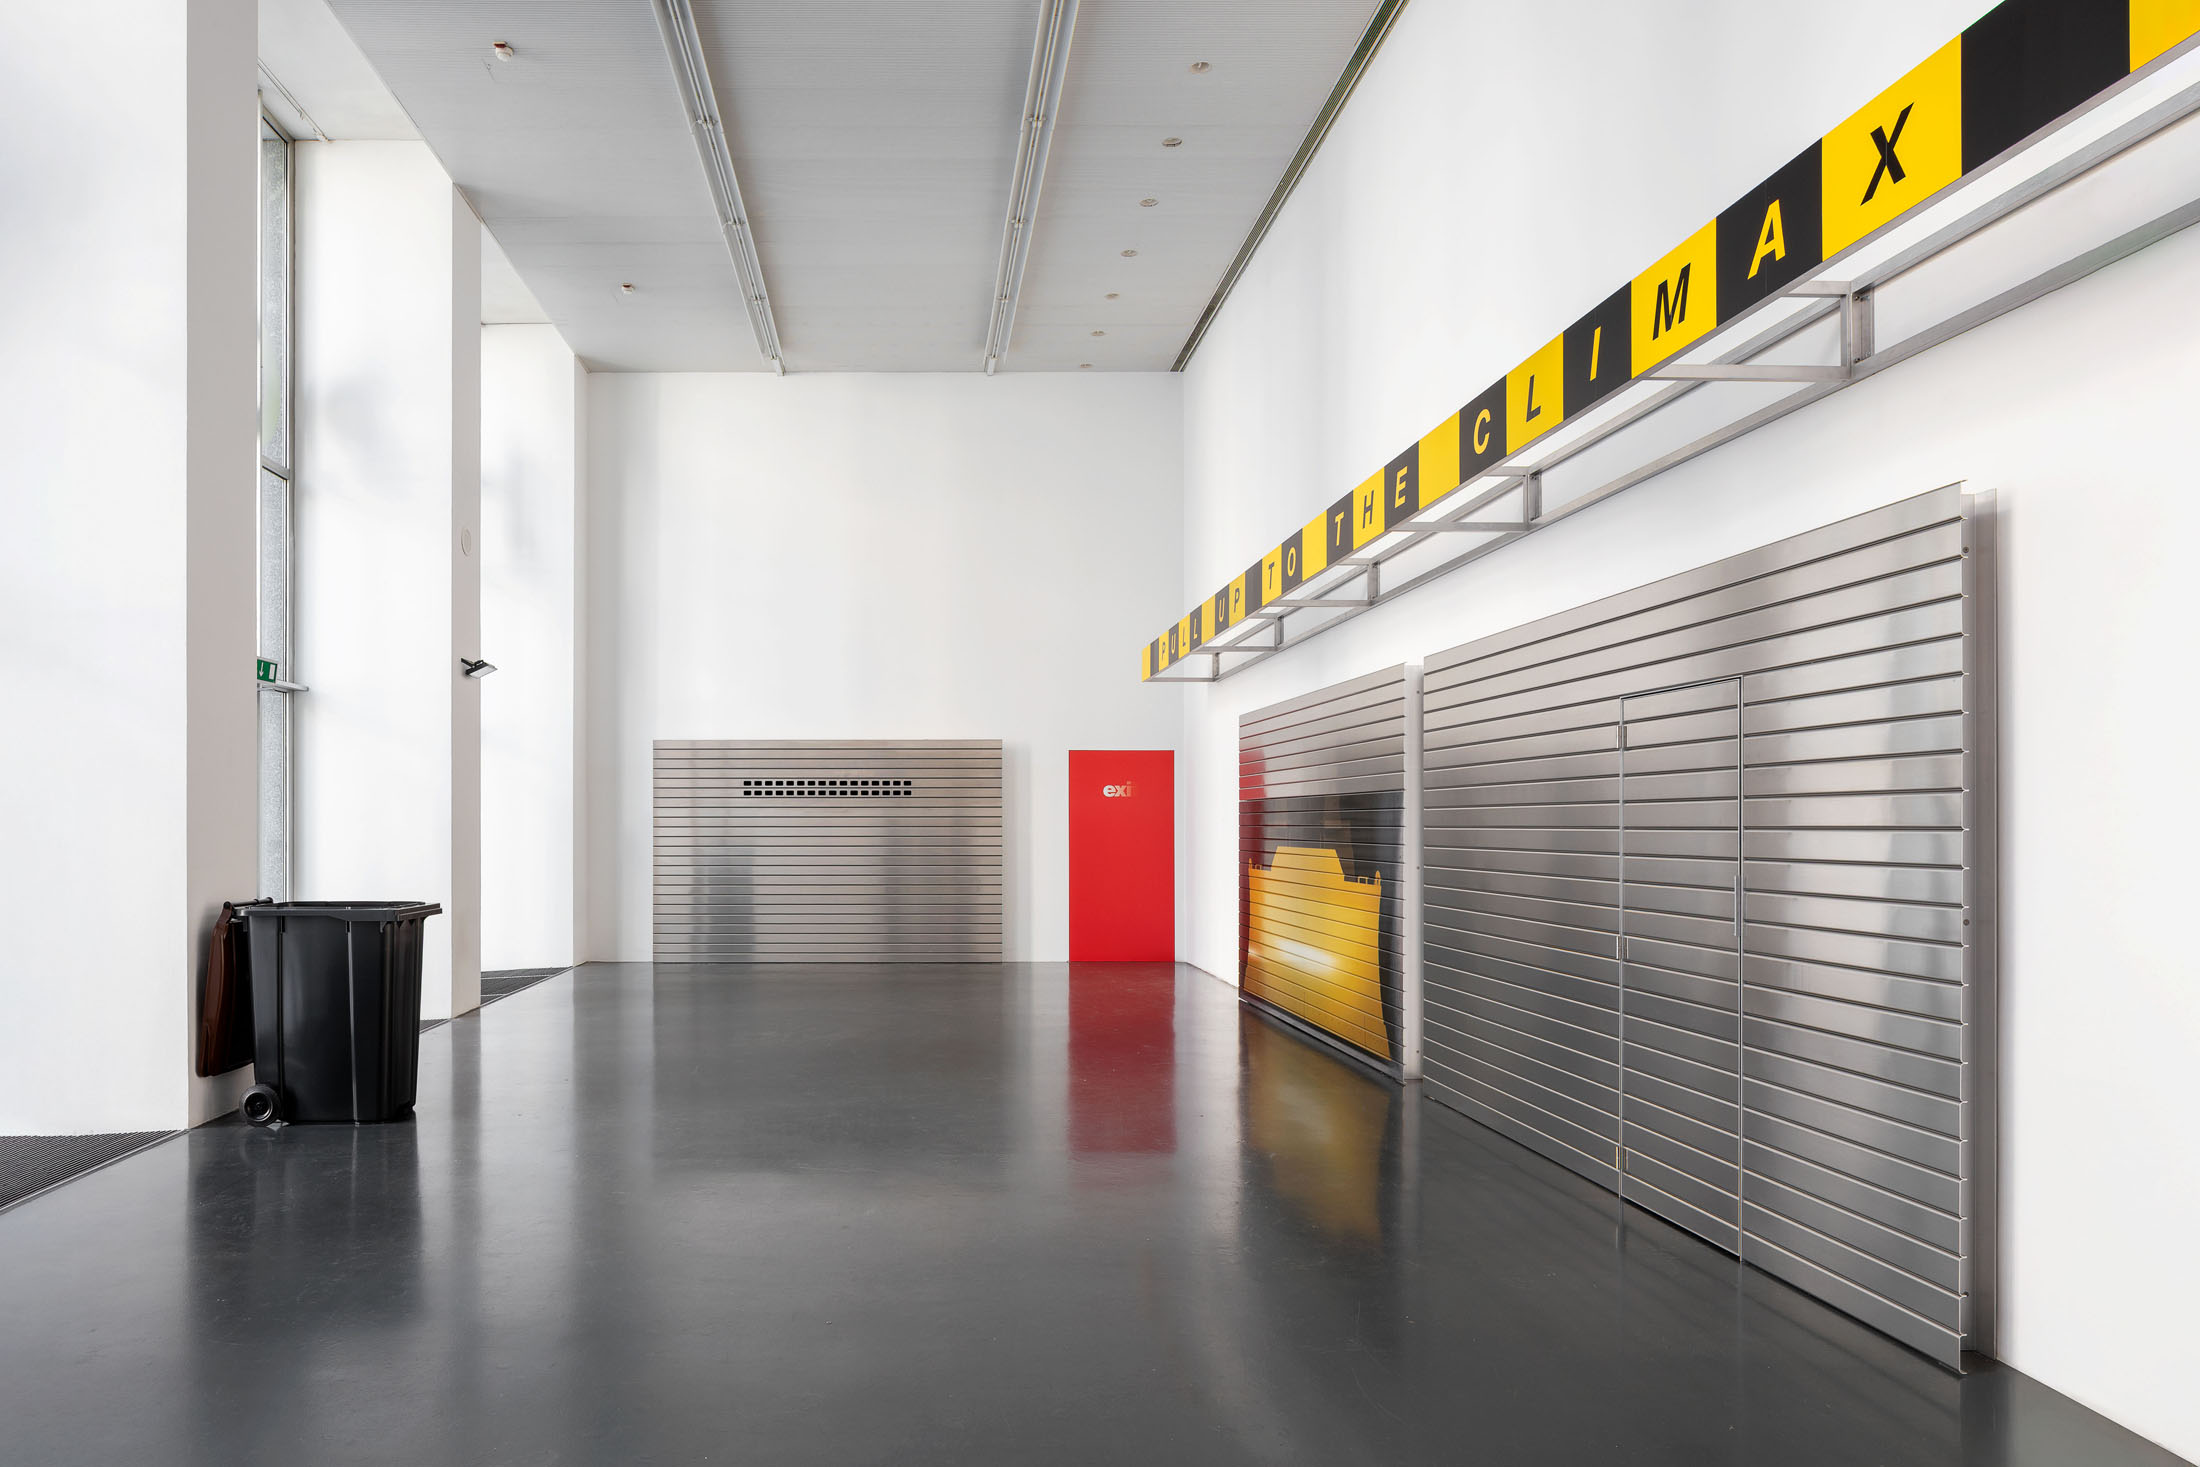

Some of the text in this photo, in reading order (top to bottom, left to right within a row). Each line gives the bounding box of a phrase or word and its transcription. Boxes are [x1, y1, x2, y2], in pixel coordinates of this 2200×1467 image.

[1161, 101, 1914, 661] PULL UP TO THE CLIMAX
